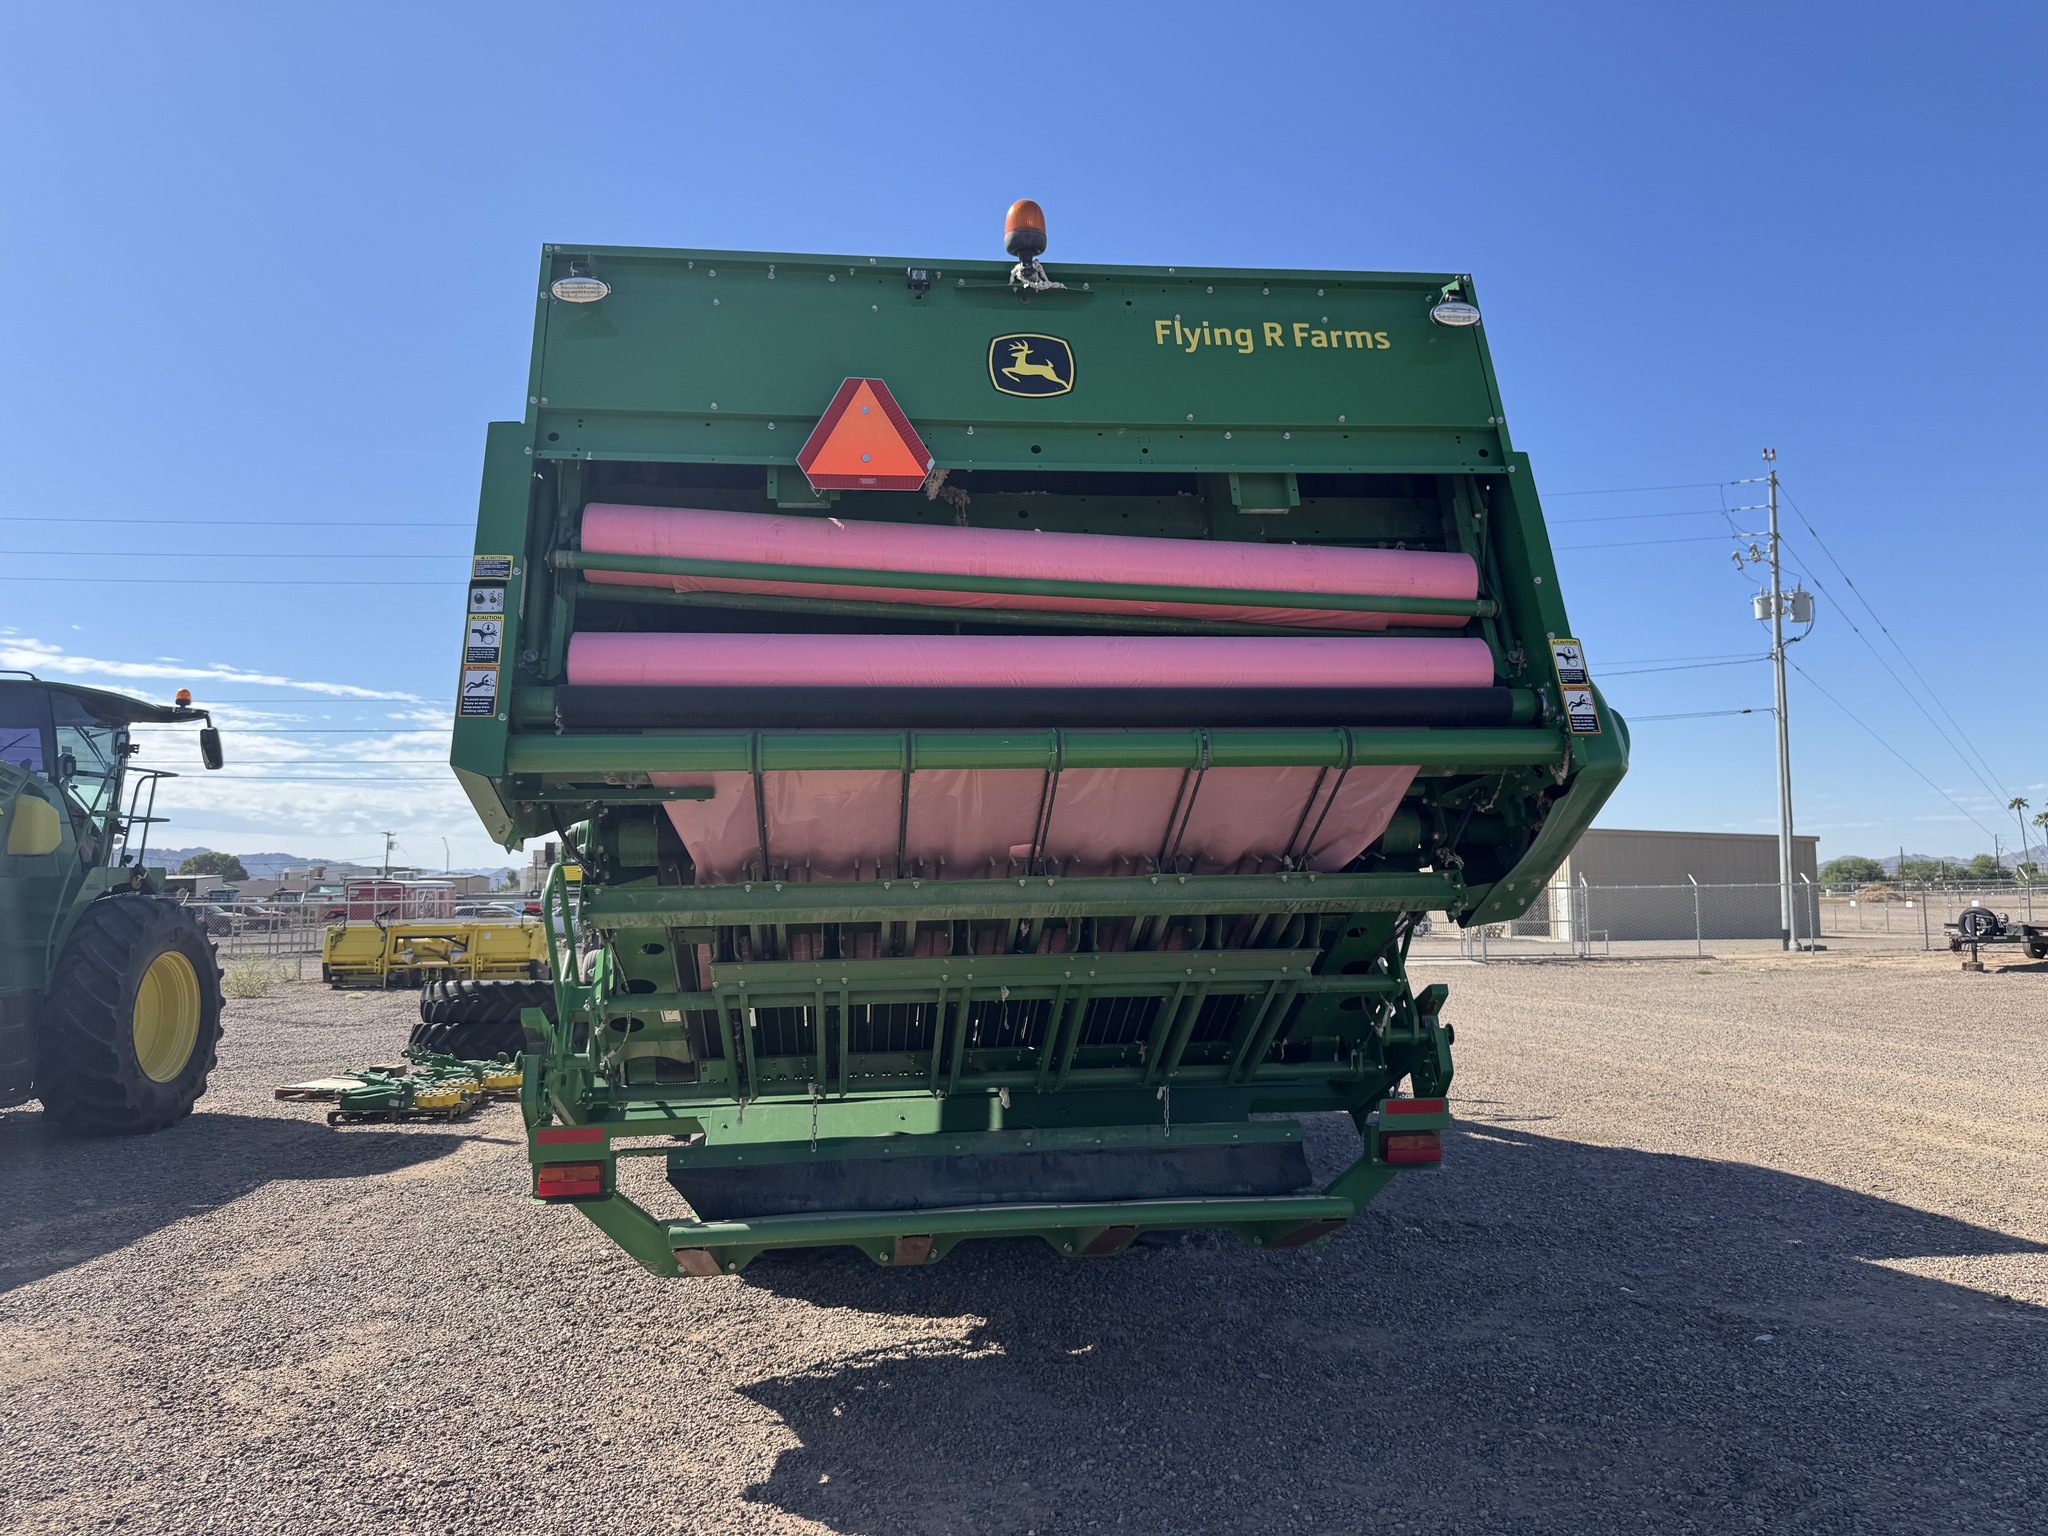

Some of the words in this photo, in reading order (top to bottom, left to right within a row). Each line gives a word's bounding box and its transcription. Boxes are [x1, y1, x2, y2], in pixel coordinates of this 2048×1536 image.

[1155, 320, 1254, 354] Flying
[1263, 322, 1285, 347] R
[1293, 323, 1391, 350] Farms
